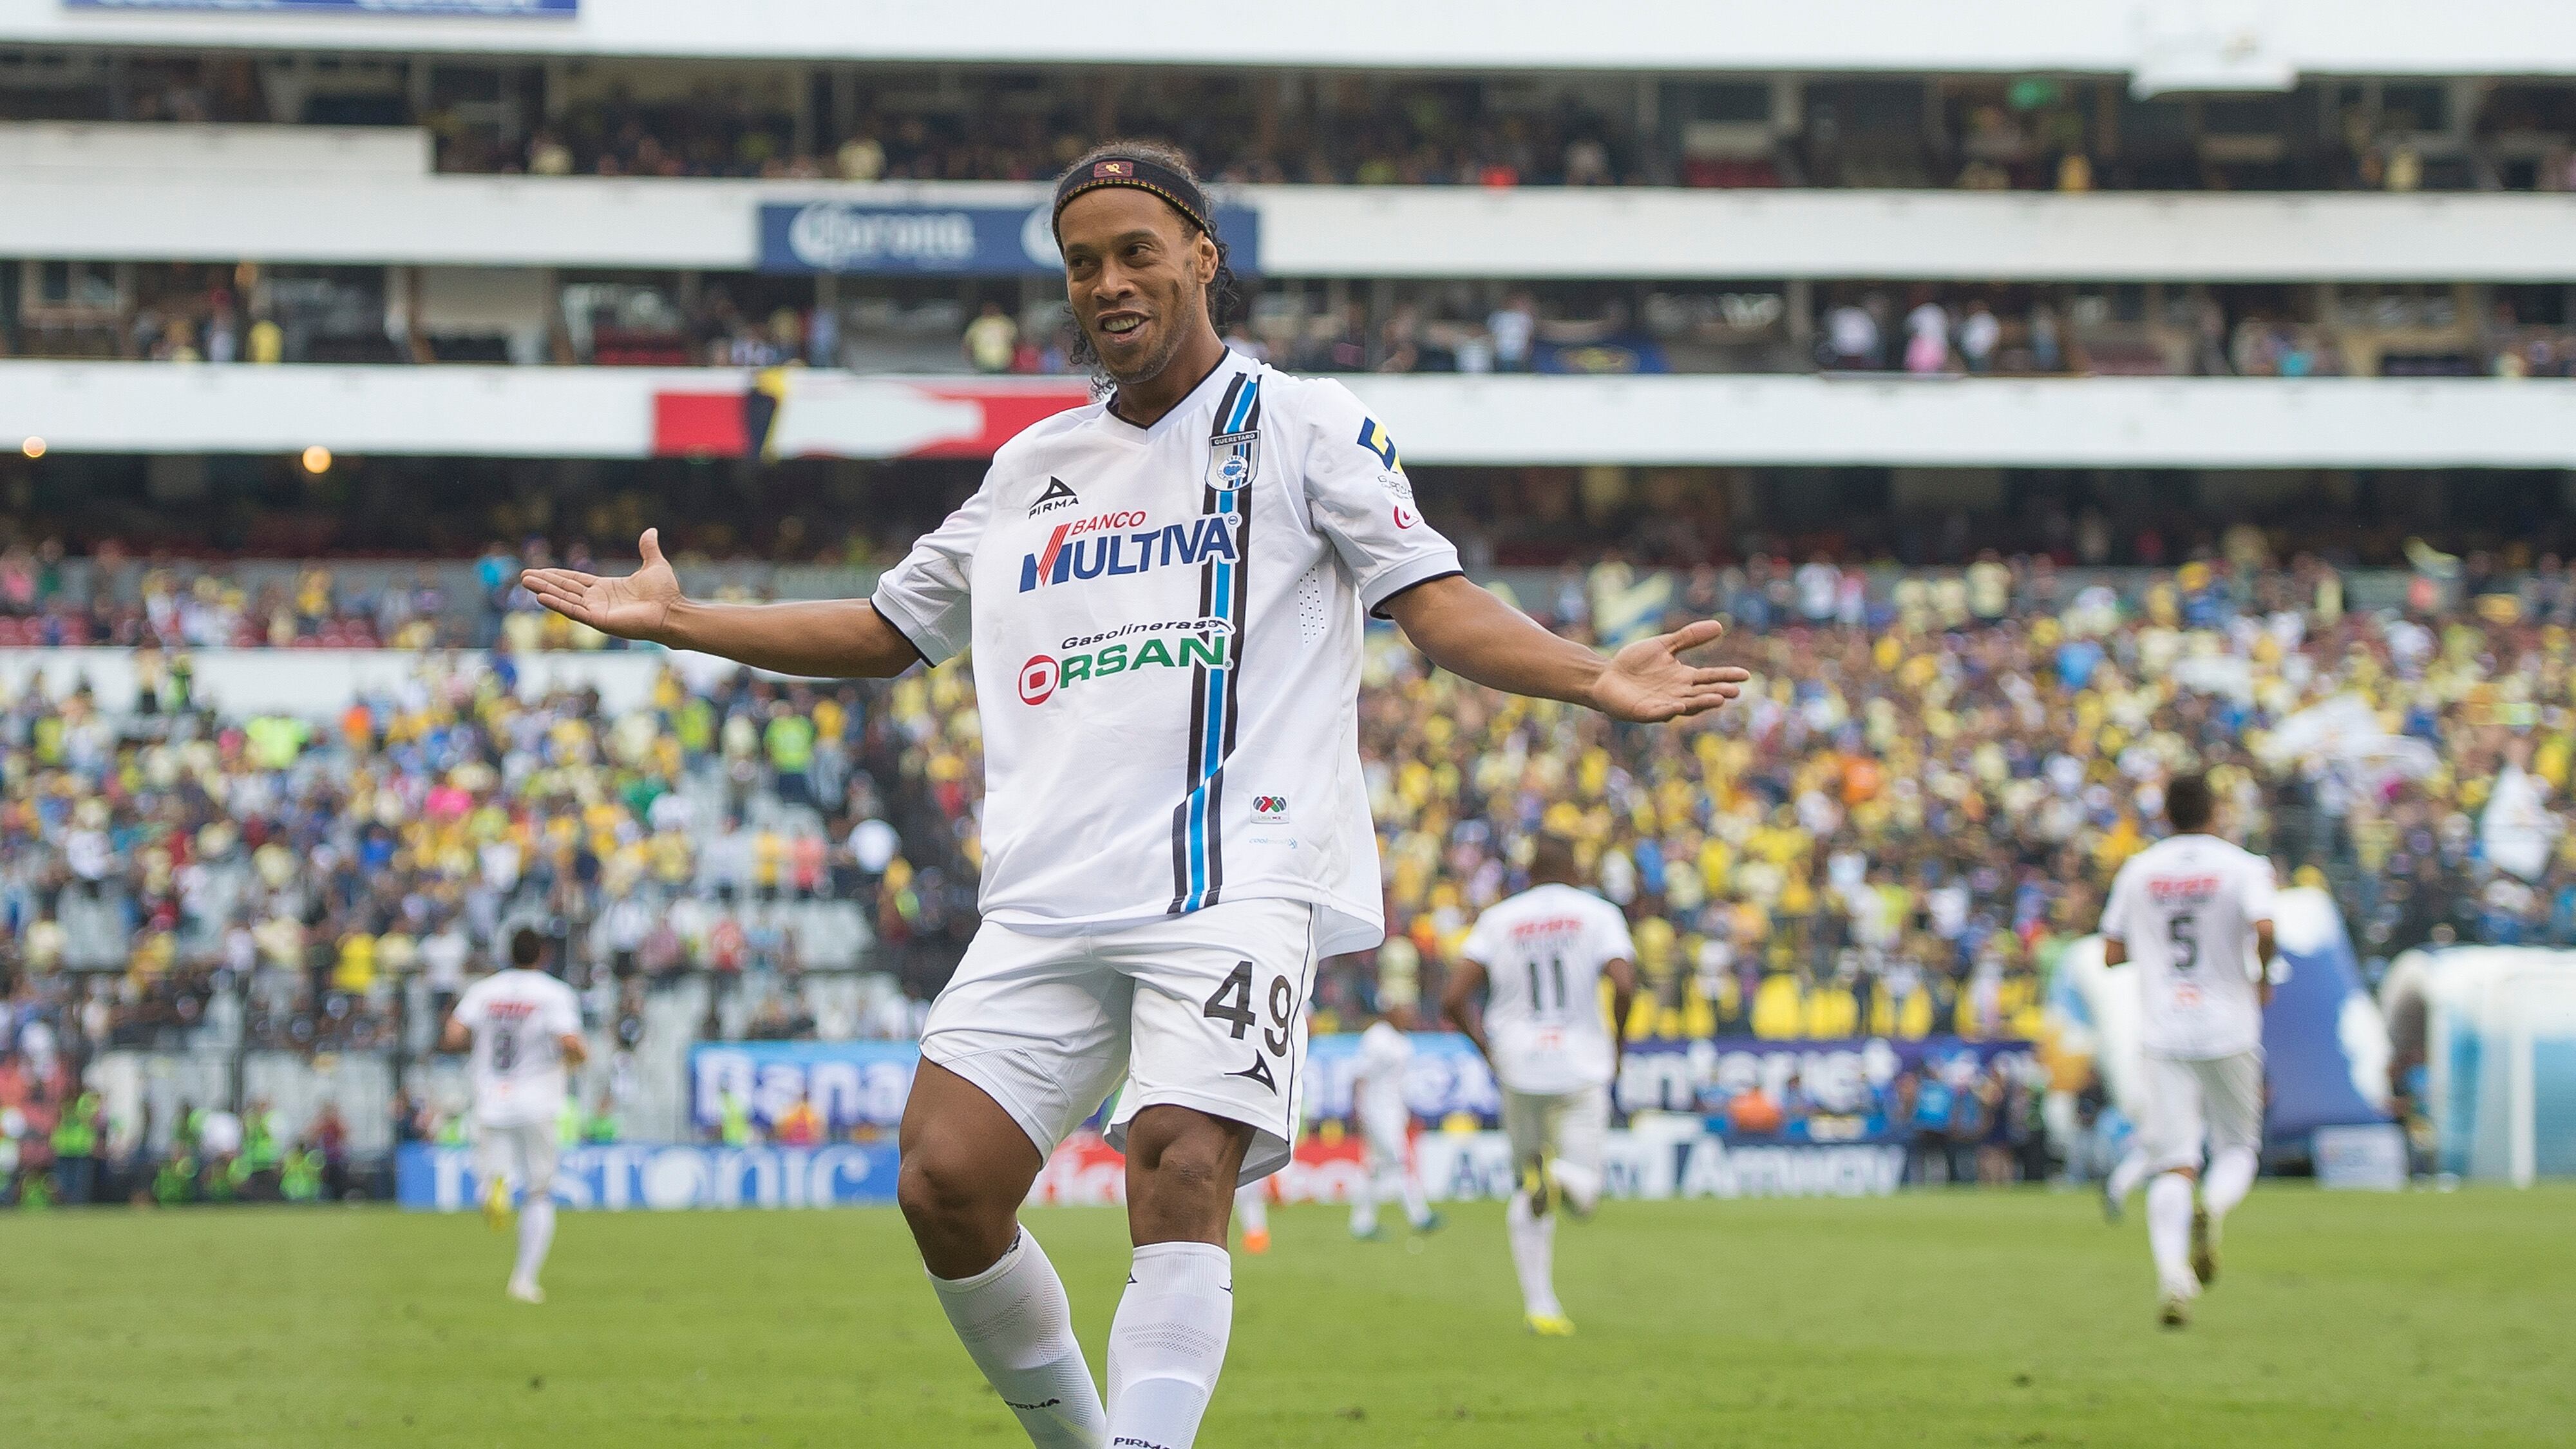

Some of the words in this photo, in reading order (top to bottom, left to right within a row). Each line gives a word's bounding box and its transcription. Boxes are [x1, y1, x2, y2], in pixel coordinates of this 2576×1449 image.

[1215, 434, 1255, 444] QUERETARO
[1028, 497, 1079, 519] PIRMA
[1070, 511, 1146, 536] BANCO
[1019, 517, 1236, 593] MULTIVA
[1061, 620, 1207, 650] Gasolineras
[1018, 636, 1224, 706] ORSAN
[2168, 913, 2199, 971] 5
[1204, 960, 1292, 1057] 49
[1527, 952, 1566, 1014] 11
[695, 1052, 903, 1127] Bana
